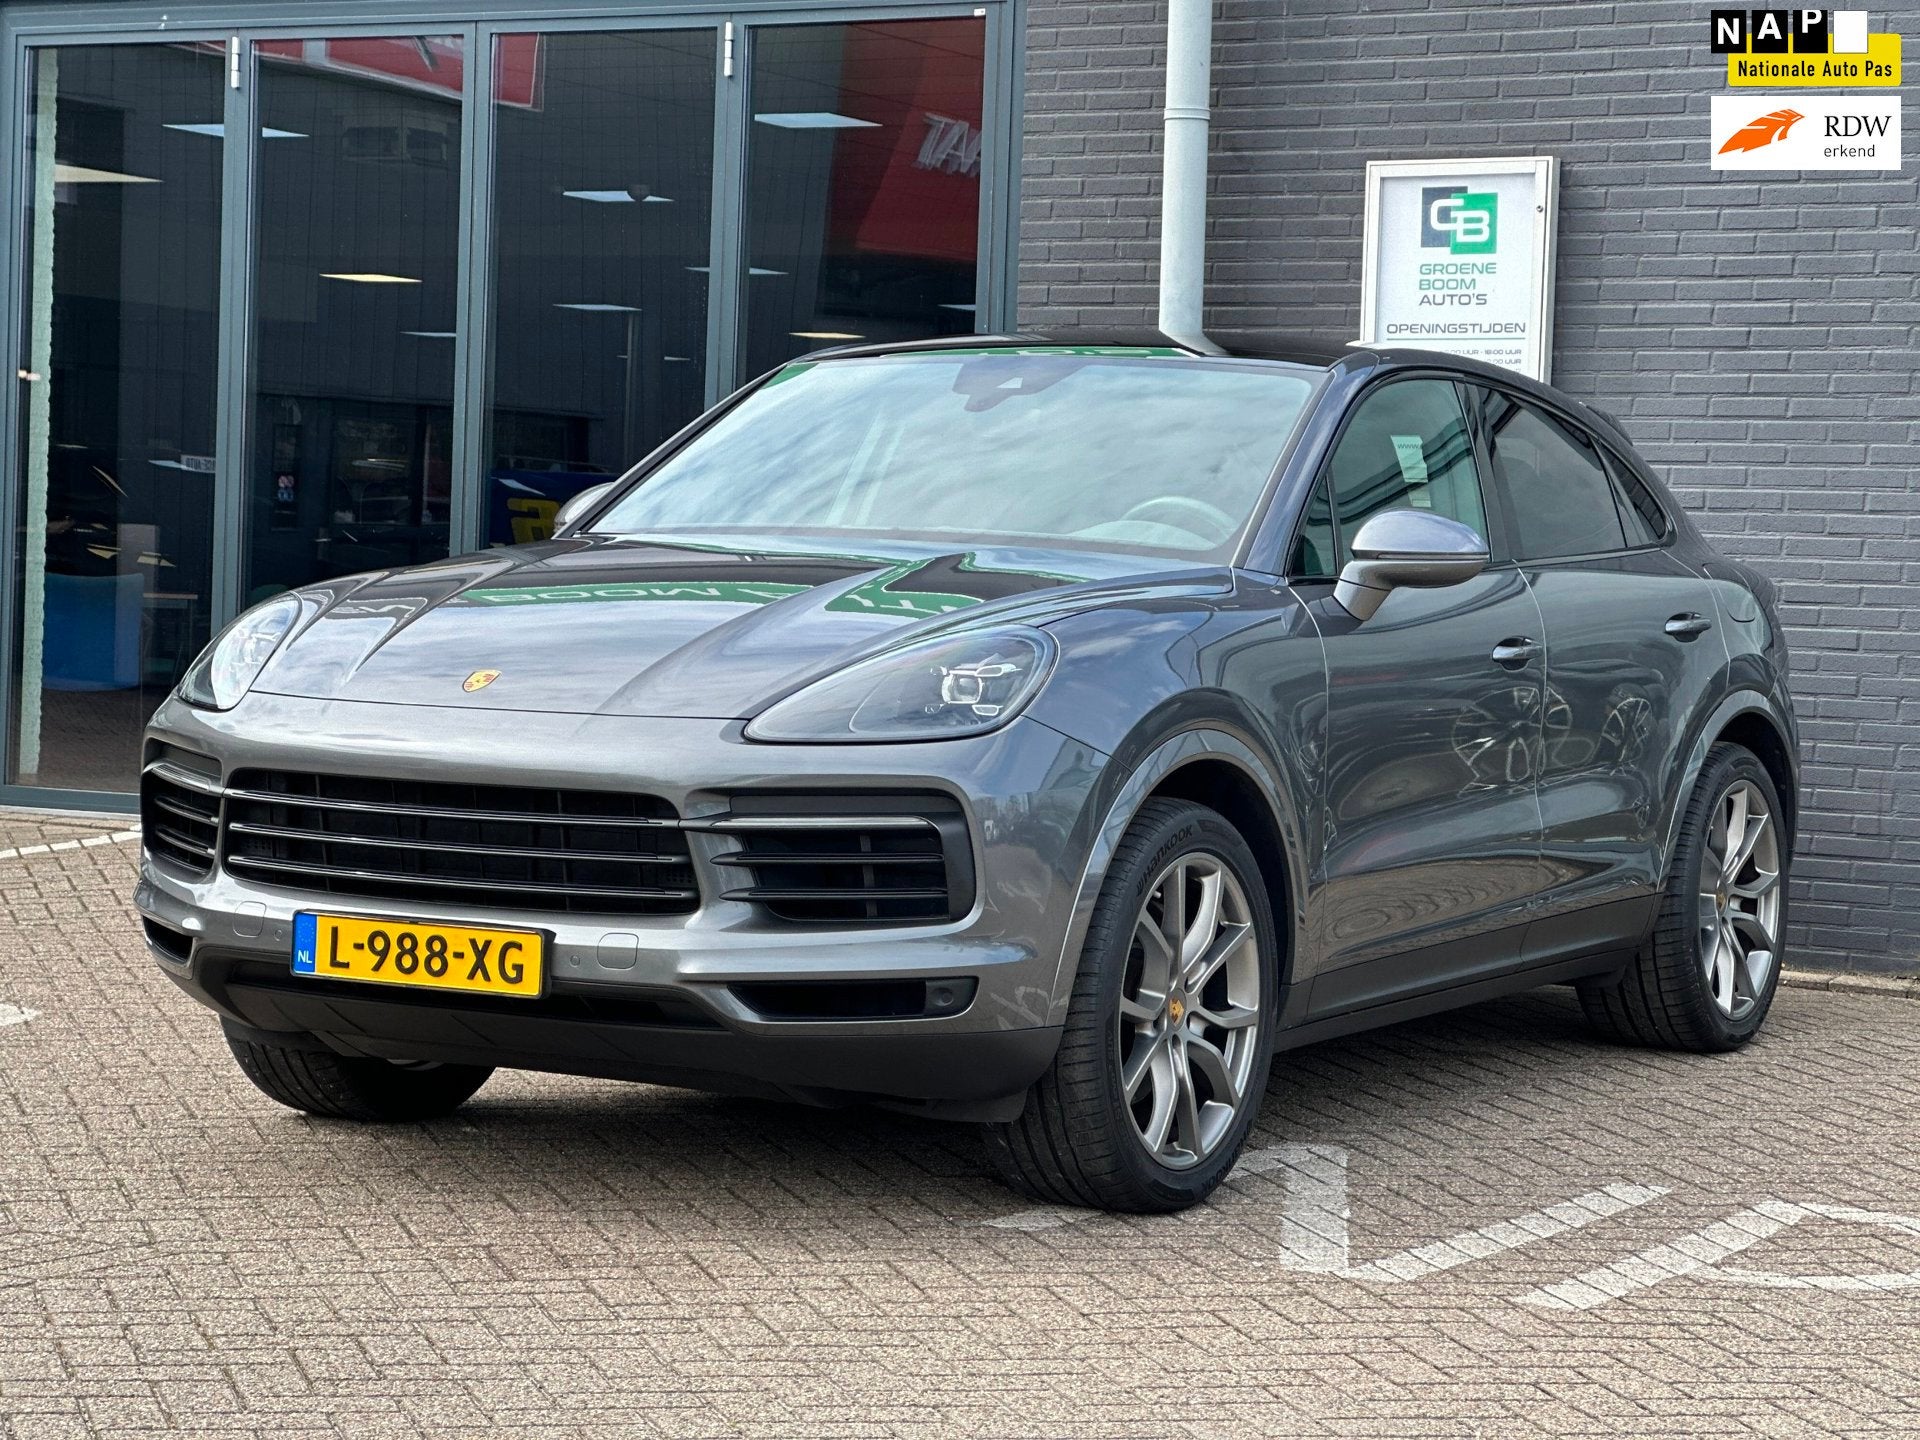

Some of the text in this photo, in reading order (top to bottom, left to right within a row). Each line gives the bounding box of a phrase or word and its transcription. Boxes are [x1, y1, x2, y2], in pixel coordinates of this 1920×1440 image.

[1419, 263, 1497, 275] GROENE
[1418, 278, 1476, 290] BOOM
[1418, 293, 1488, 306] AUTO'S
[1386, 322, 1526, 334] OPENINGSTIJDEN
[297, 925, 524, 985] NL L-988-XG
